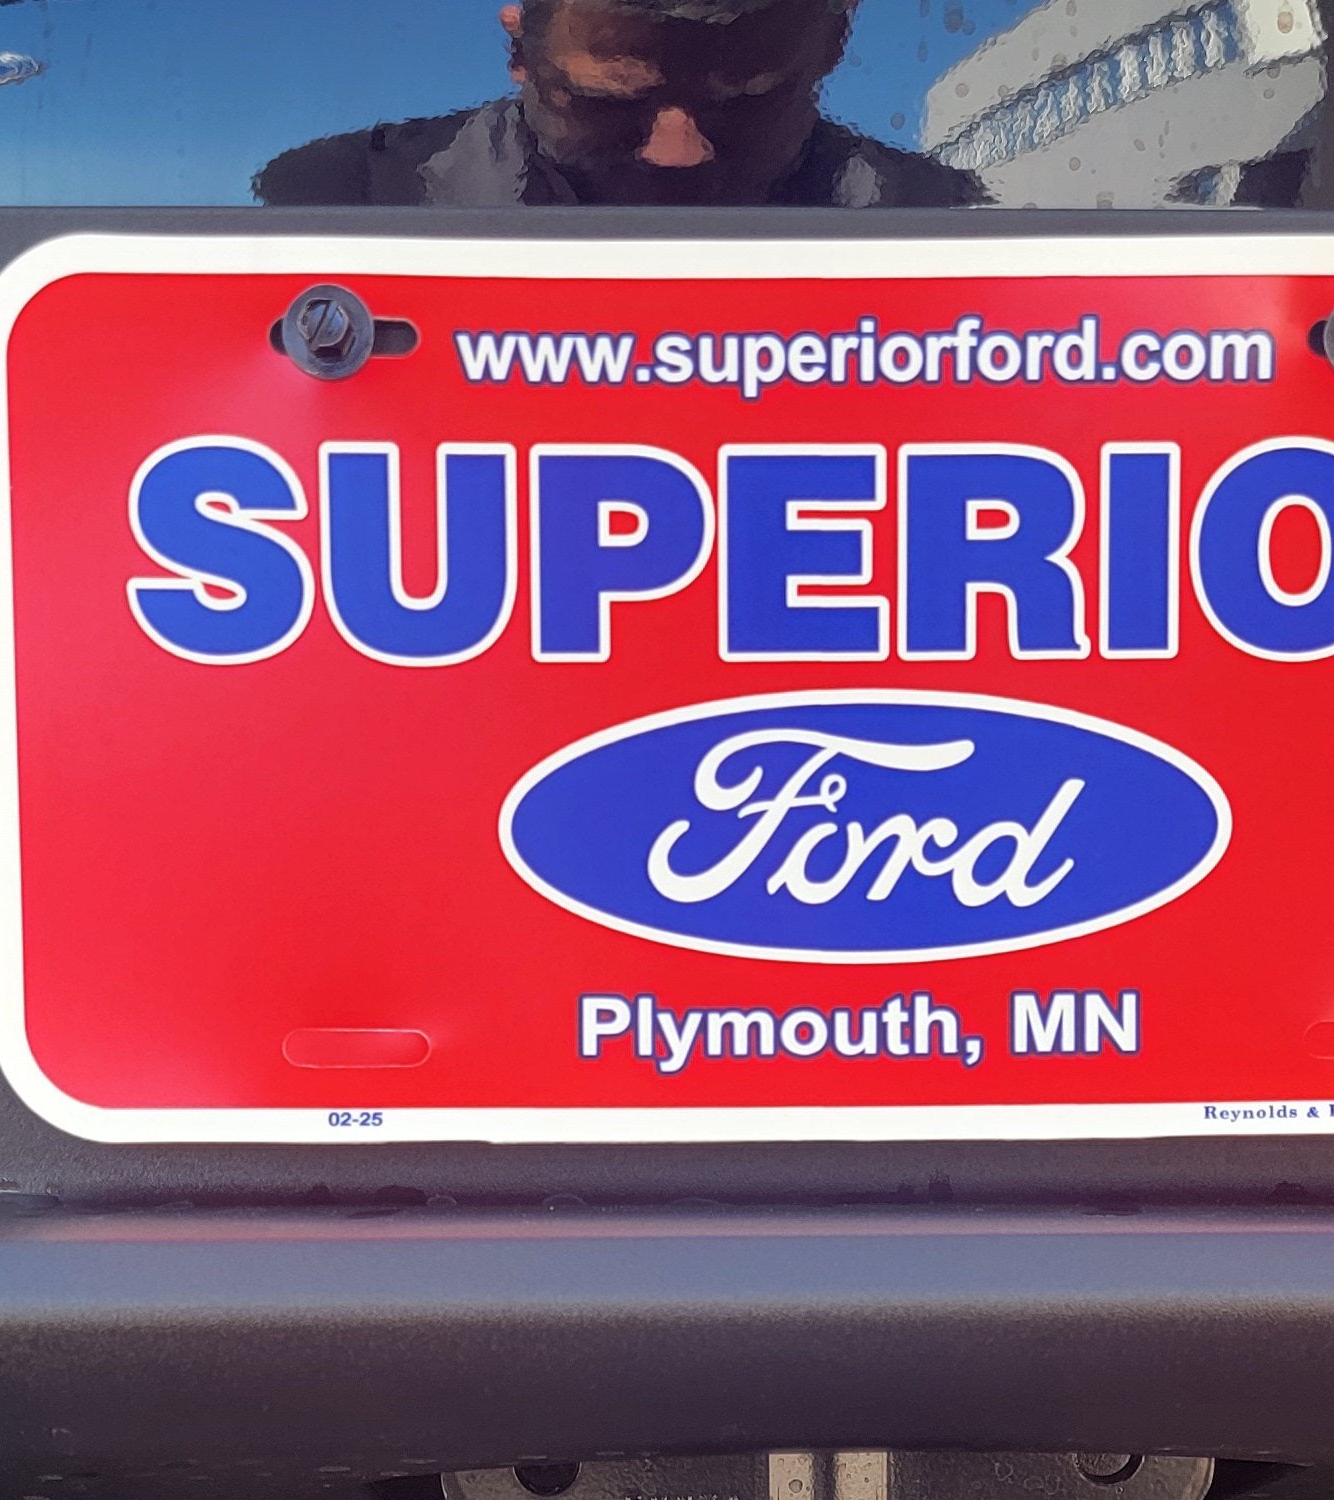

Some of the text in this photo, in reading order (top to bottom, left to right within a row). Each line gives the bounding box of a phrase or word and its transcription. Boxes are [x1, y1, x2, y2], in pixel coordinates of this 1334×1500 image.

[455, 316, 1274, 399] www.superiorford.com
[647, 728, 1085, 908] Ford
[578, 991, 1141, 1072] Plymouth, MN
[327, 1111, 384, 1127] 02-25
[1203, 1104, 1299, 1122] Reynolds
[1306, 1106, 1321, 1120] &
